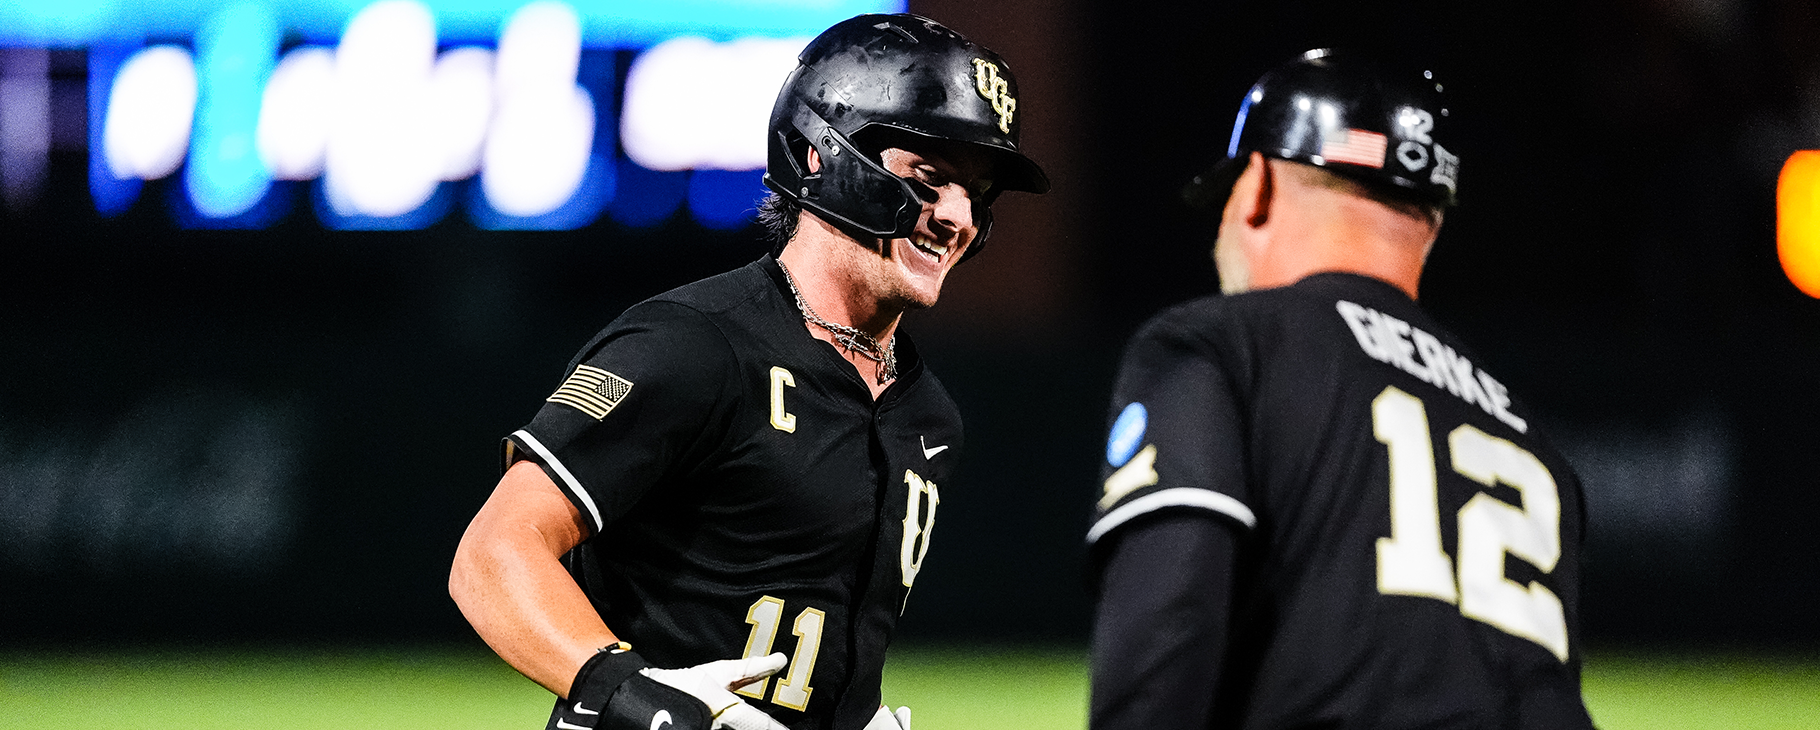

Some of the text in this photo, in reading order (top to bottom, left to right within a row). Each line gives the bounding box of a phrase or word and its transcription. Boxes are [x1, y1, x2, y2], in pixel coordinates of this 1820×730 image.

[973, 58, 1016, 134] UCF
[769, 365, 796, 434] C
[1335, 300, 1528, 434] GIERKE
[1372, 385, 1568, 663] 12
[735, 595, 826, 712] 11
